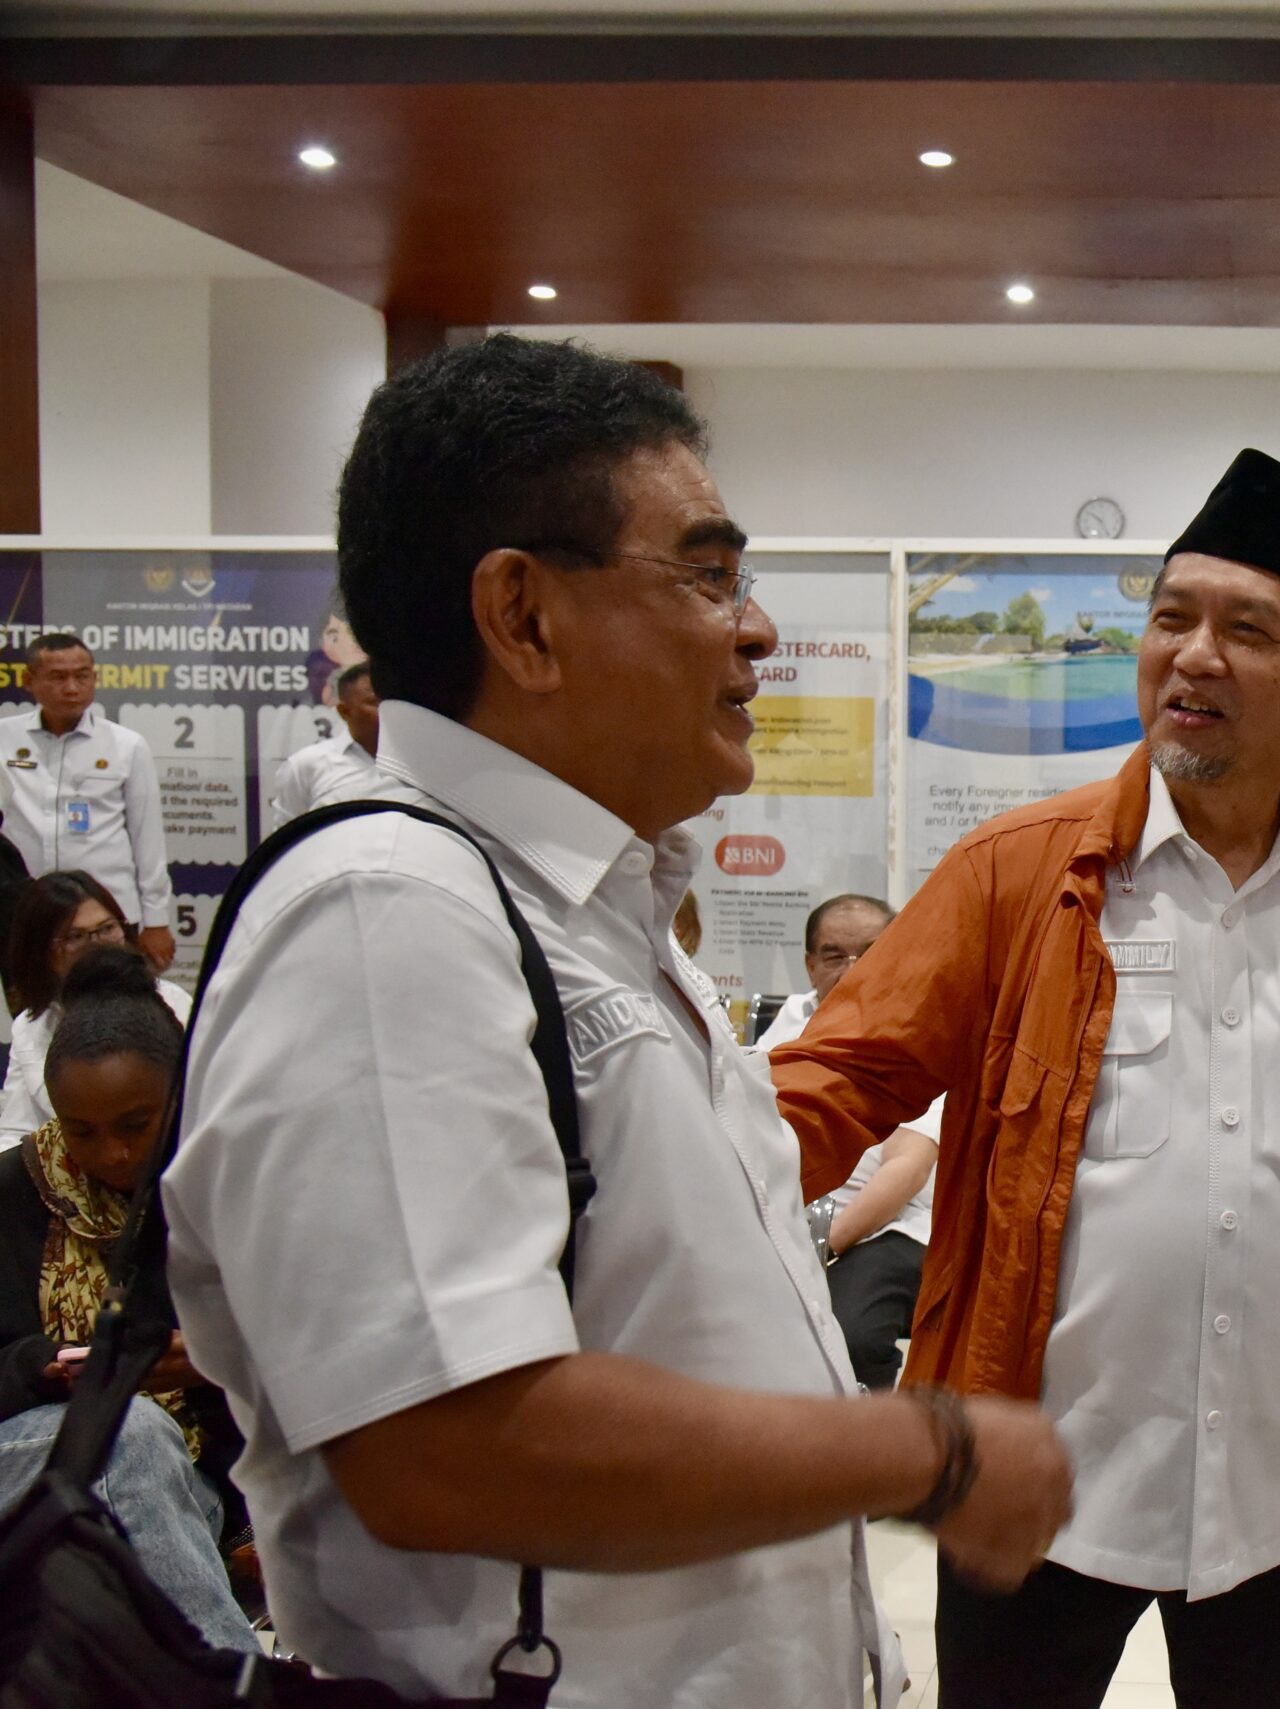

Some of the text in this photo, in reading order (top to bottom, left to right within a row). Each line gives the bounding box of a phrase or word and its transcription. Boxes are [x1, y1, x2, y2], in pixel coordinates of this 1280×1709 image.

[82, 625, 118, 650] OF
[124, 625, 310, 652] IMMIGRATION
[772, 642, 871, 662] STERCARD,
[94, 663, 170, 690] ERMIT
[174, 664, 309, 692] SERVICES
[173, 716, 195, 749] 2
[929, 785, 962, 801] Every
[966, 785, 1024, 799] Foreigner
[932, 801, 966, 813] notify
[968, 804, 990, 813] any
[187, 825, 237, 836] payment
[924, 816, 947, 826] and
[957, 818, 970, 827] or
[742, 847, 775, 865] BNI
[177, 905, 197, 937] 5
